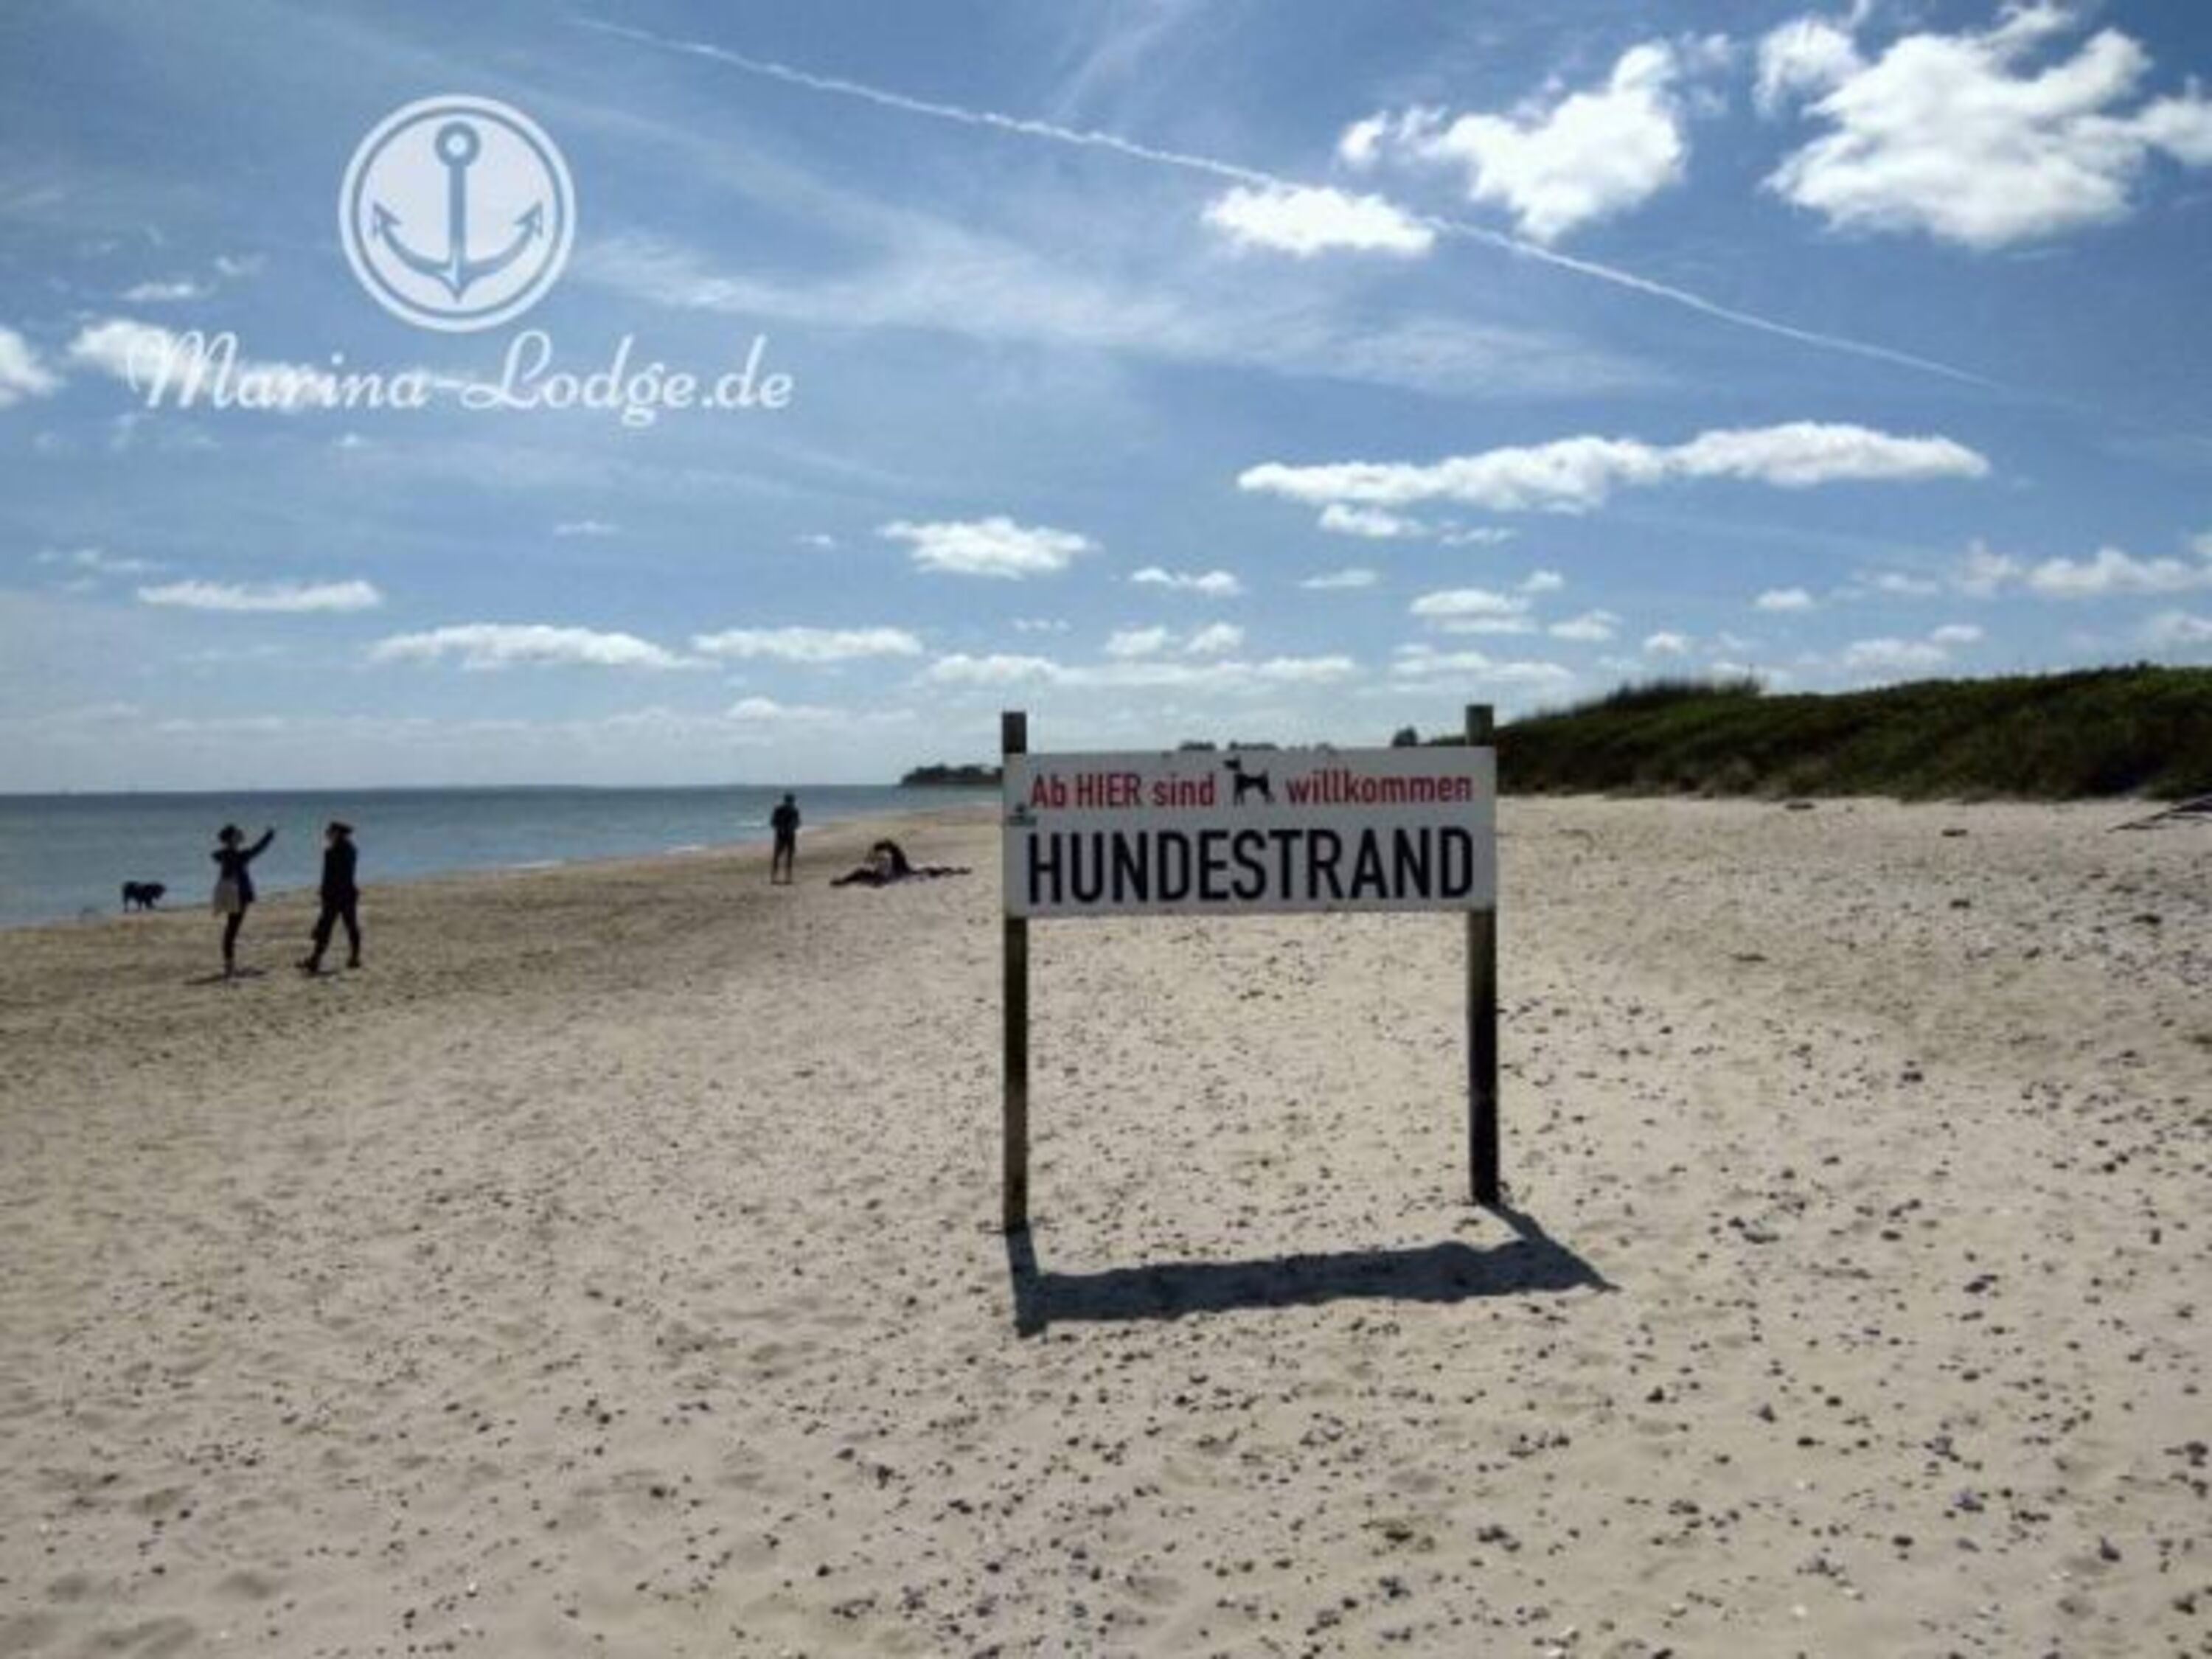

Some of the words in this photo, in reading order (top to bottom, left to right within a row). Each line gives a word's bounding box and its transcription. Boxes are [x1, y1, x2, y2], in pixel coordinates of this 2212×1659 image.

[1032, 772, 1066, 807] Ab
[1077, 771, 1141, 807] HIER
[1153, 771, 1214, 806] sind
[1286, 768, 1472, 804] willkommen
[1029, 827, 1473, 904] HUNDESTRAND
